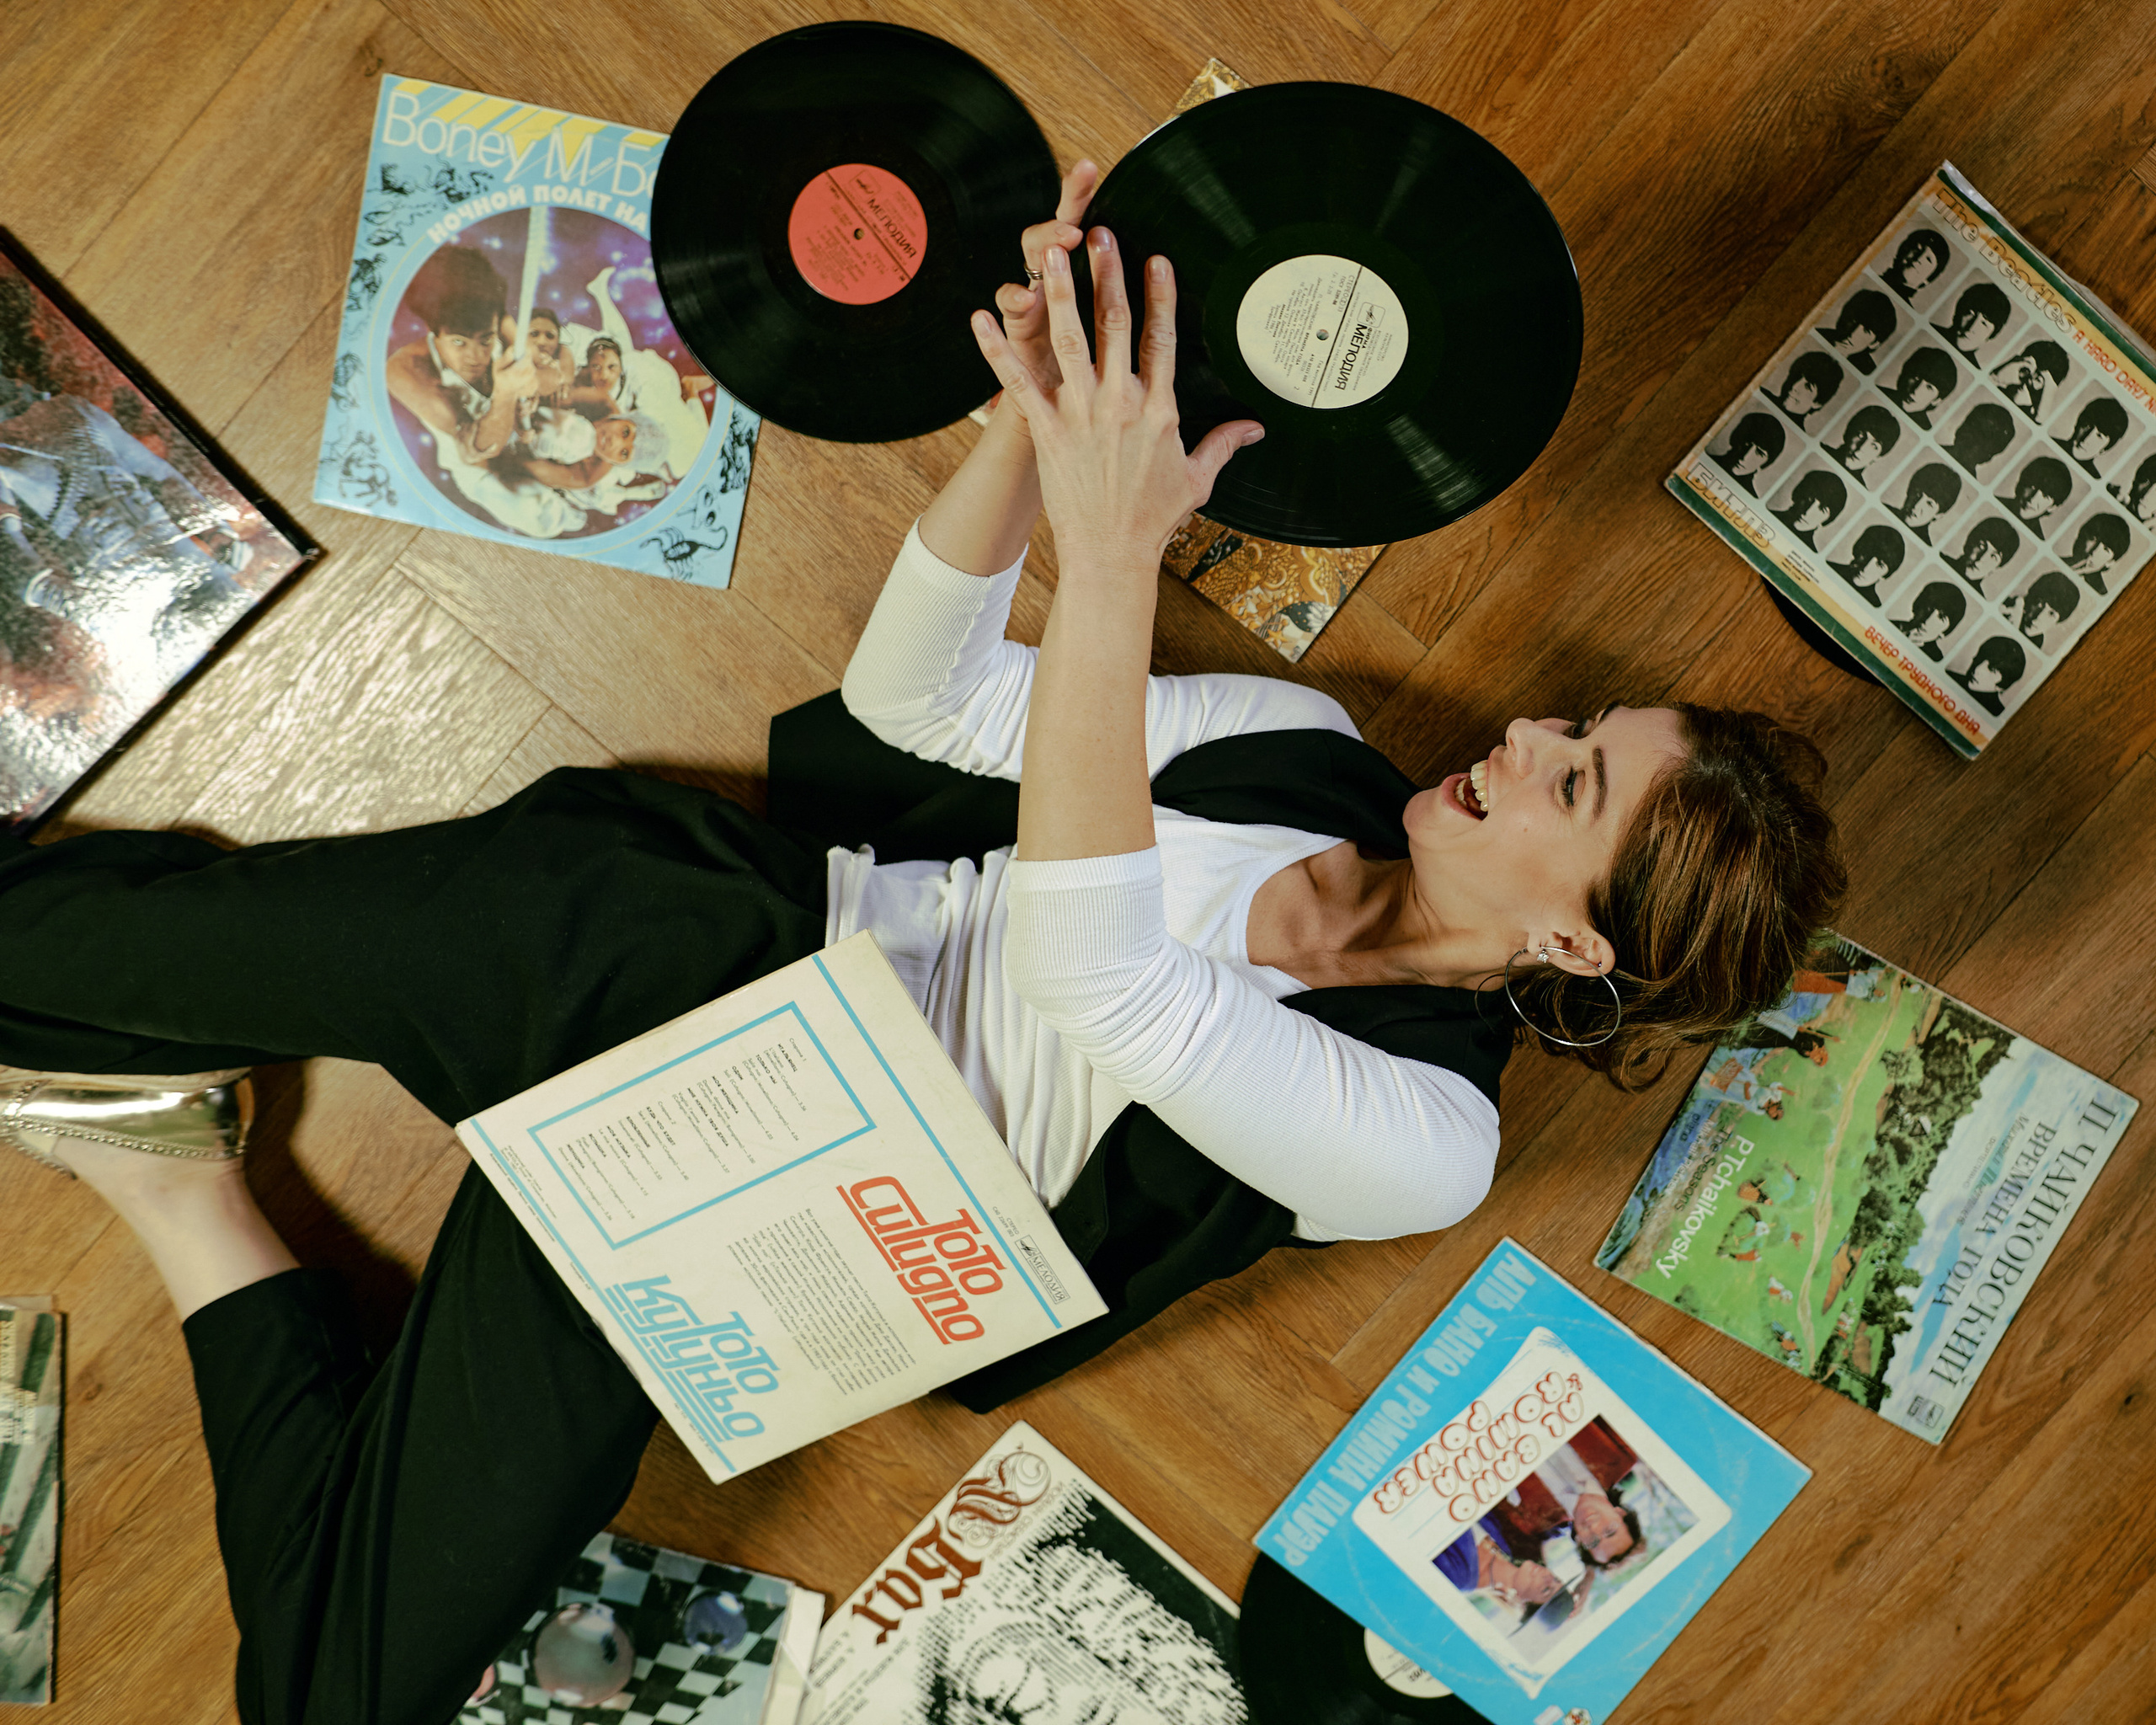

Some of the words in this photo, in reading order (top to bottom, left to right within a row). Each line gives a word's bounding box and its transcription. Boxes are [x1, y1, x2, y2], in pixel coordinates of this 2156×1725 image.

[382, 91, 537, 183] Boney
[545, 126, 593, 186] M
[611, 142, 654, 198] Б
[427, 184, 526, 243] НОЧНОЙ
[533, 184, 612, 211] ПОЛЕТ
[615, 200, 648, 232] НА
[1926, 186, 1988, 245] The
[1977, 234, 2083, 336] Beatles
[1333, 322, 1367, 391] МЕЛОДИЯ
[1361, 327, 1373, 349] ФИРМА
[2071, 328, 2087, 344] A
[2082, 339, 2119, 376] HARD
[1684, 461, 1779, 551] БИТЛЗ
[1861, 624, 1902, 662] ВЕЧЕР
[1896, 655, 1958, 714] ТРУДНОГО
[1952, 708, 1982, 736] ДНЯ
[730, 1065, 744, 1081] ОДНИ
[754, 1053, 771, 1074] ТОЛЬКО
[1707, 1125, 1732, 1156] The
[2079, 1098, 2119, 1135] П.
[1673, 1151, 1717, 1215] Seasons
[1976, 1121, 2057, 1236] ВРЕМЕНА
[1006, 1216, 1020, 1235] СТЕРЕО
[1032, 1255, 1065, 1300] МЕЛОДИЯ
[1477, 1252, 1537, 1311] АЛЬ
[1929, 1142, 2097, 1389] ЧАЙКОВСКИЙ
[1931, 1244, 1978, 1308] ГОДА
[1423, 1305, 1498, 1377] БАНО
[1329, 1385, 1432, 1493] РОМИНА
[1432, 1372, 1566, 1498] ROMINA
[1541, 1391, 1585, 1438] AL
[1373, 1400, 1492, 1514] POWER
[1449, 1434, 1541, 1523] BANO
[1273, 1481, 1353, 1567] ПАУЭР
